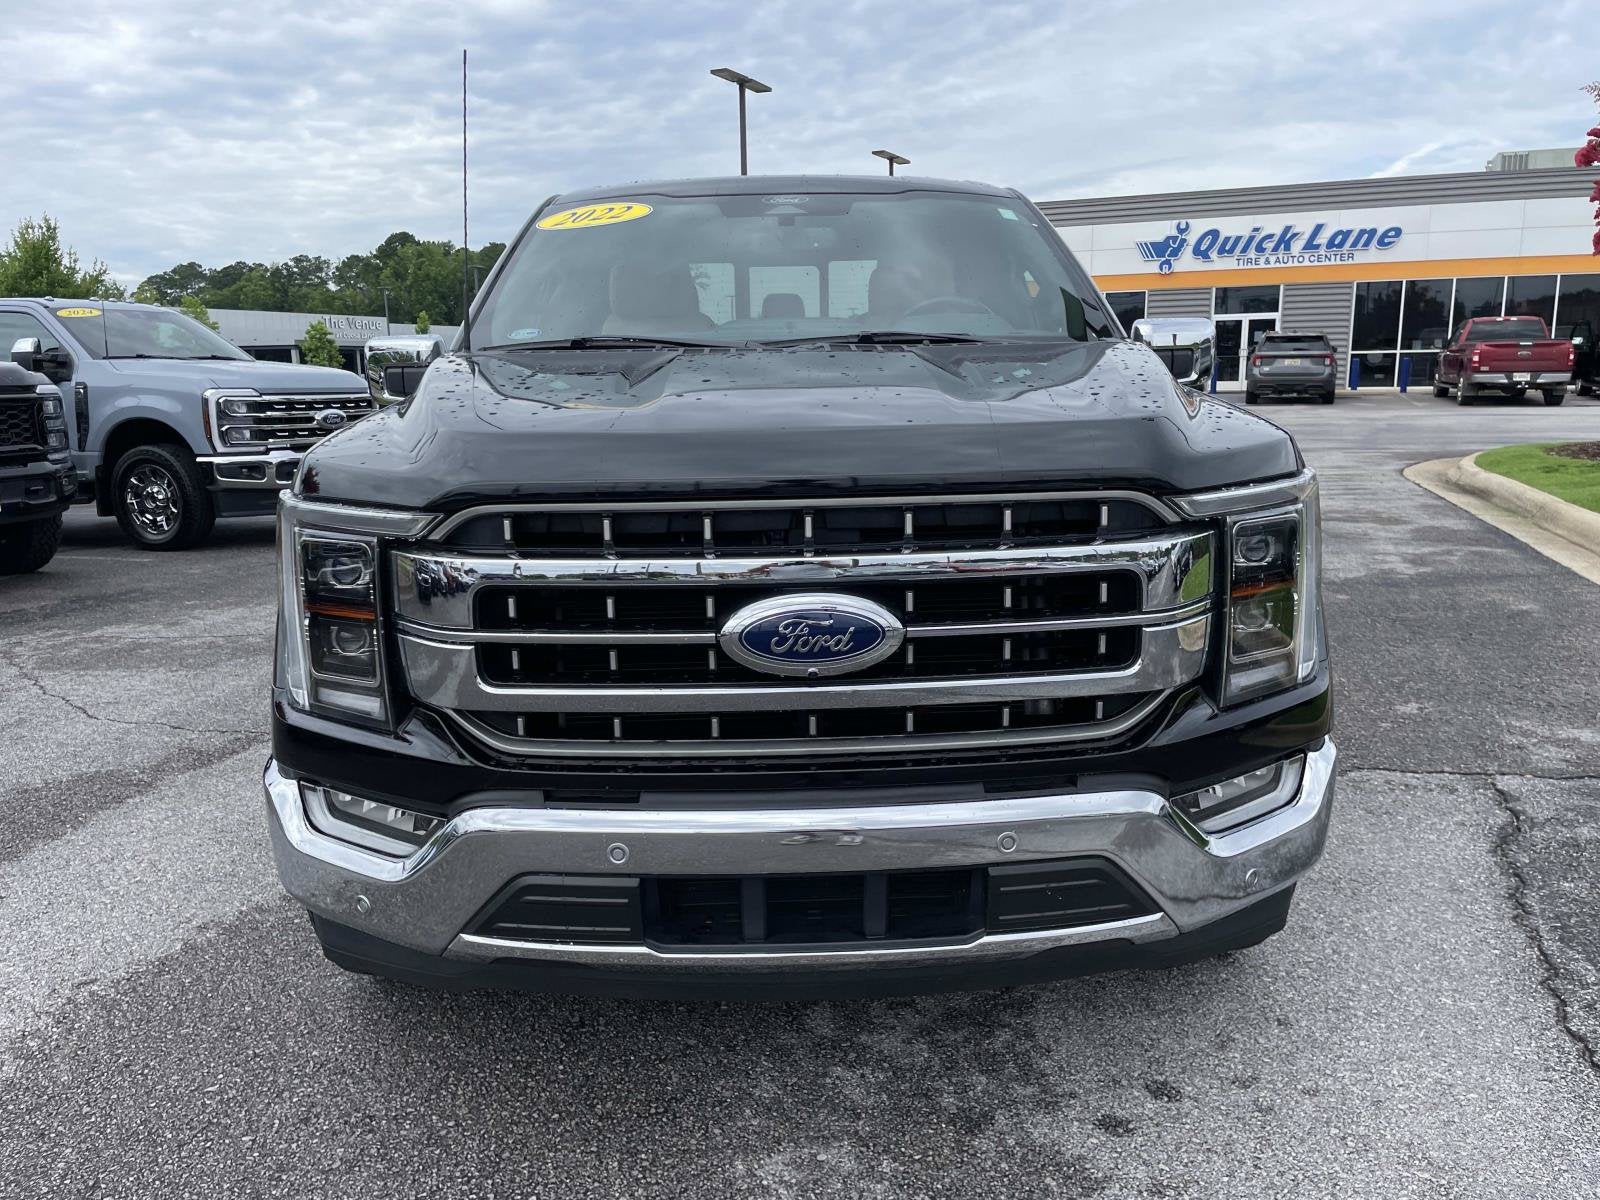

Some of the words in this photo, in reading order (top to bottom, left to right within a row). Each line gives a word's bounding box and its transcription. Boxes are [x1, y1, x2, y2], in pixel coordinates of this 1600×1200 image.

[549, 205, 633, 227] 2022
[1191, 225, 1301, 261] Quick
[1300, 222, 1403, 252] Lane
[1235, 256, 1260, 267] TIRE
[1264, 256, 1271, 265] &
[1274, 254, 1305, 265] AUTO
[1308, 252, 1355, 263] CENTER
[65, 309, 94, 317] 2024
[321, 315, 345, 329] The
[346, 316, 382, 330] Venue
[770, 618, 855, 653] Ford
